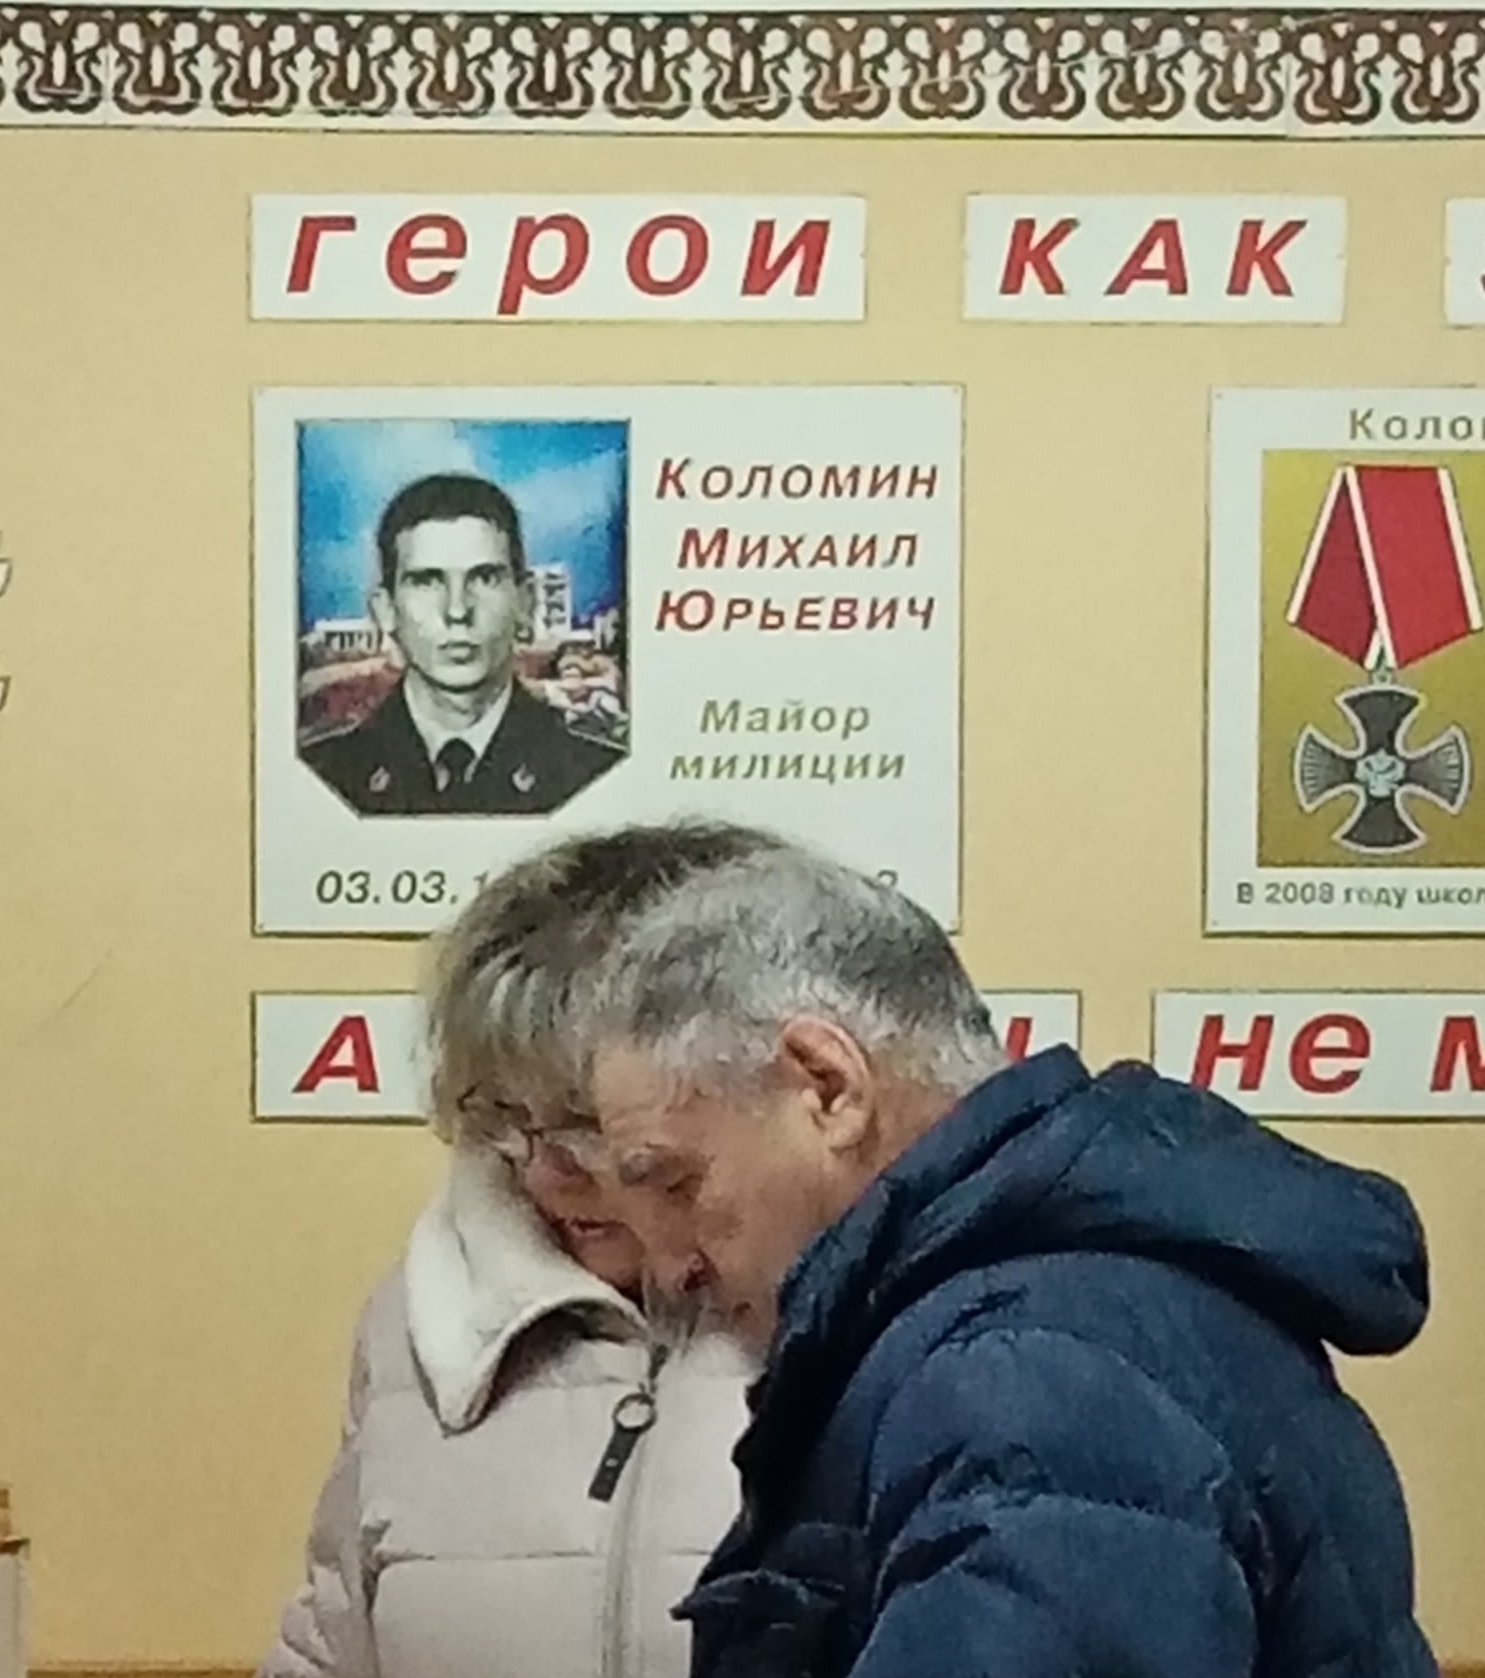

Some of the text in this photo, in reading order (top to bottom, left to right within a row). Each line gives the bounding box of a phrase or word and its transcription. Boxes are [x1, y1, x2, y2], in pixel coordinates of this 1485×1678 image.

[286, 215, 1308, 316] герои КАК
[1349, 407, 1485, 441] Коло
[699, 698, 871, 741] Майор
[669, 753, 905, 786] милиции
[1236, 881, 1254, 905] В
[1264, 881, 1335, 905] 2008
[1343, 887, 1409, 910] году
[1190, 1014, 1372, 1094] не
